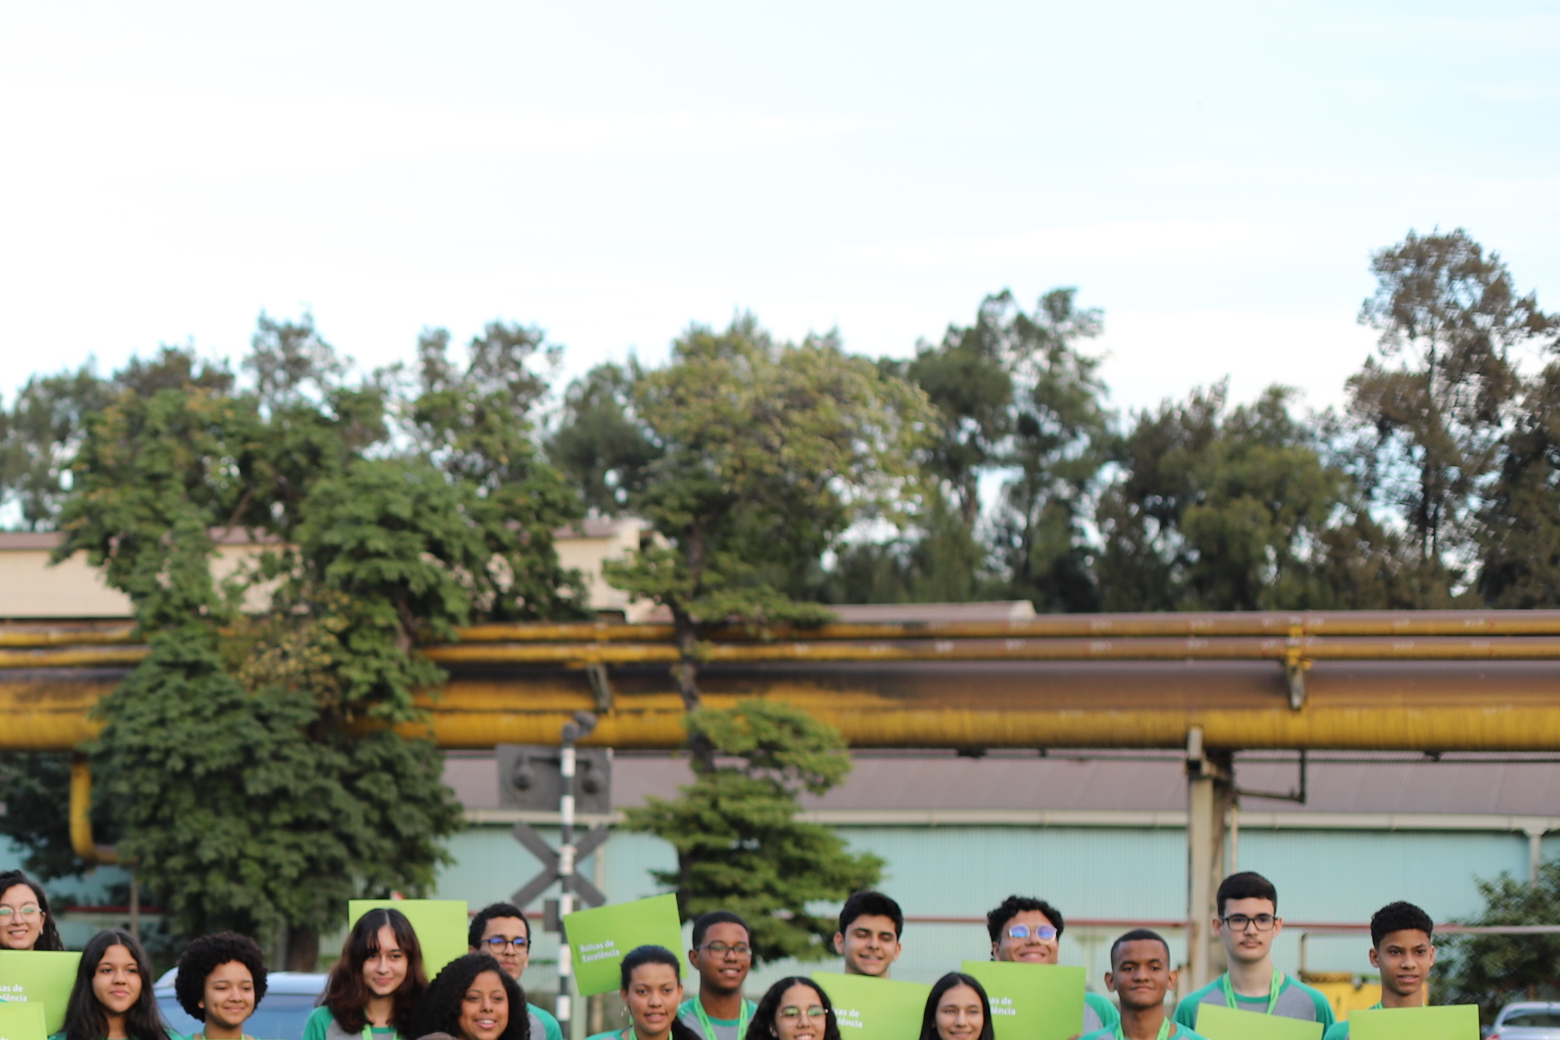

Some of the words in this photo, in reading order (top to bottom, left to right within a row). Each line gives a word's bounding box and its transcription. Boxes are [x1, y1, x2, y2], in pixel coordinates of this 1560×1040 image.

[580, 943, 604, 953] Bolsas
[605, 939, 615, 948] de
[582, 949, 620, 963] Excelência
[12, 983, 23, 992] de
[1001, 996, 1013, 1005] de
[848, 1008, 860, 1018] de
